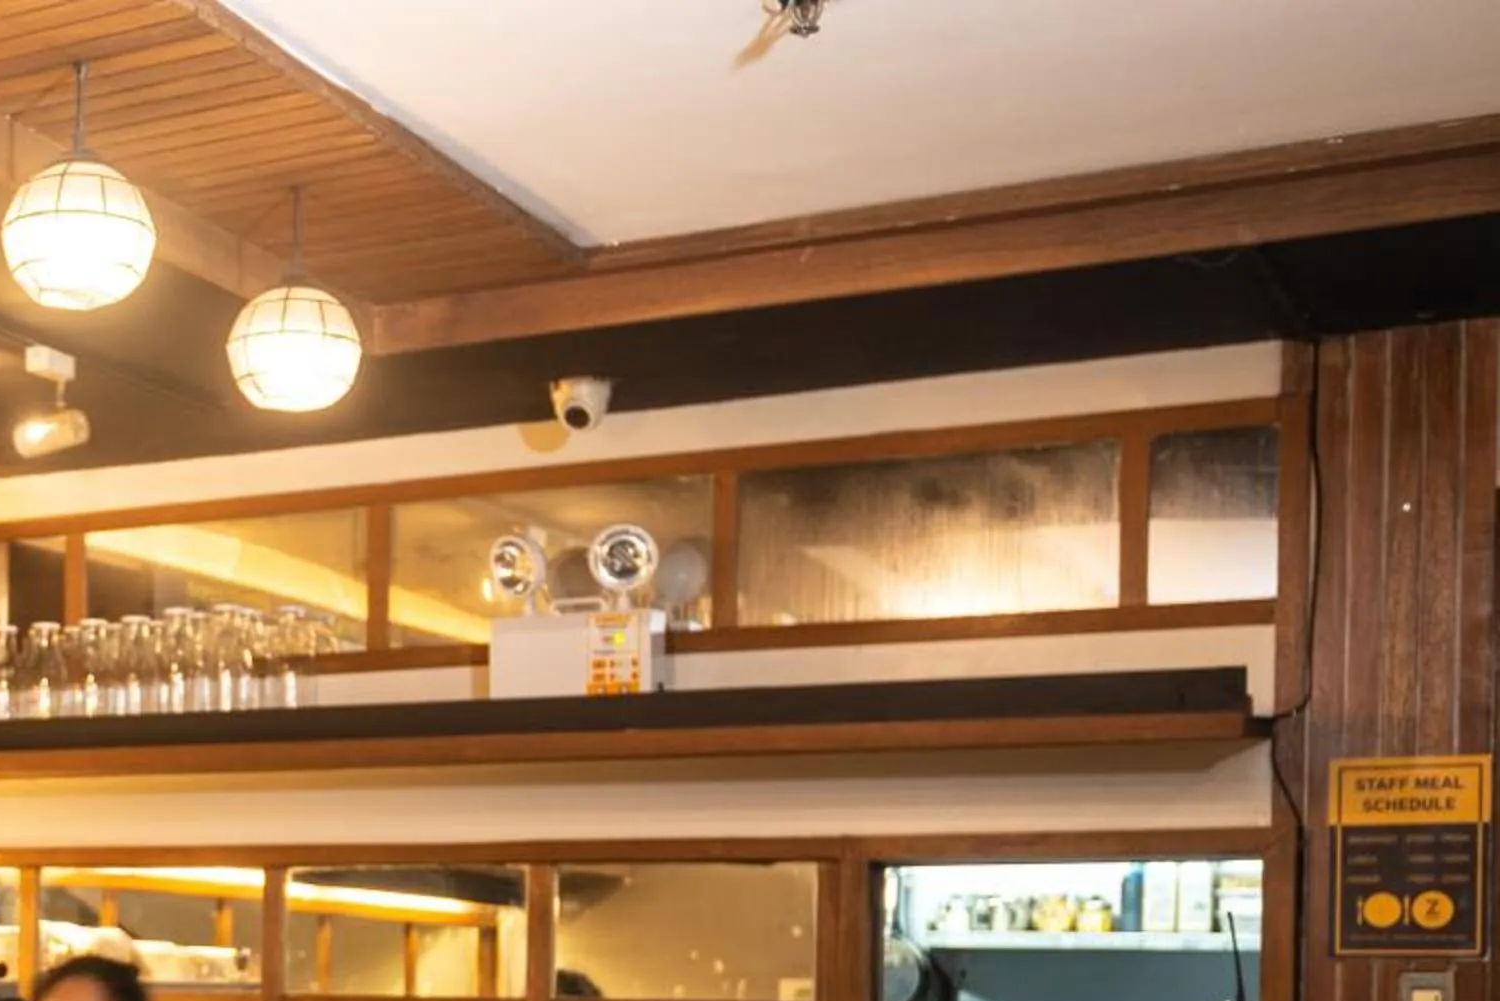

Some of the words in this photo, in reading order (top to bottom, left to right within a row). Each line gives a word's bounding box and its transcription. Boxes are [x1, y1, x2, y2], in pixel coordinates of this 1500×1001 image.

[1355, 776, 1409, 791] STAFF
[1414, 776, 1465, 790] MEAL
[1362, 797, 1456, 813] SCHEDULE
